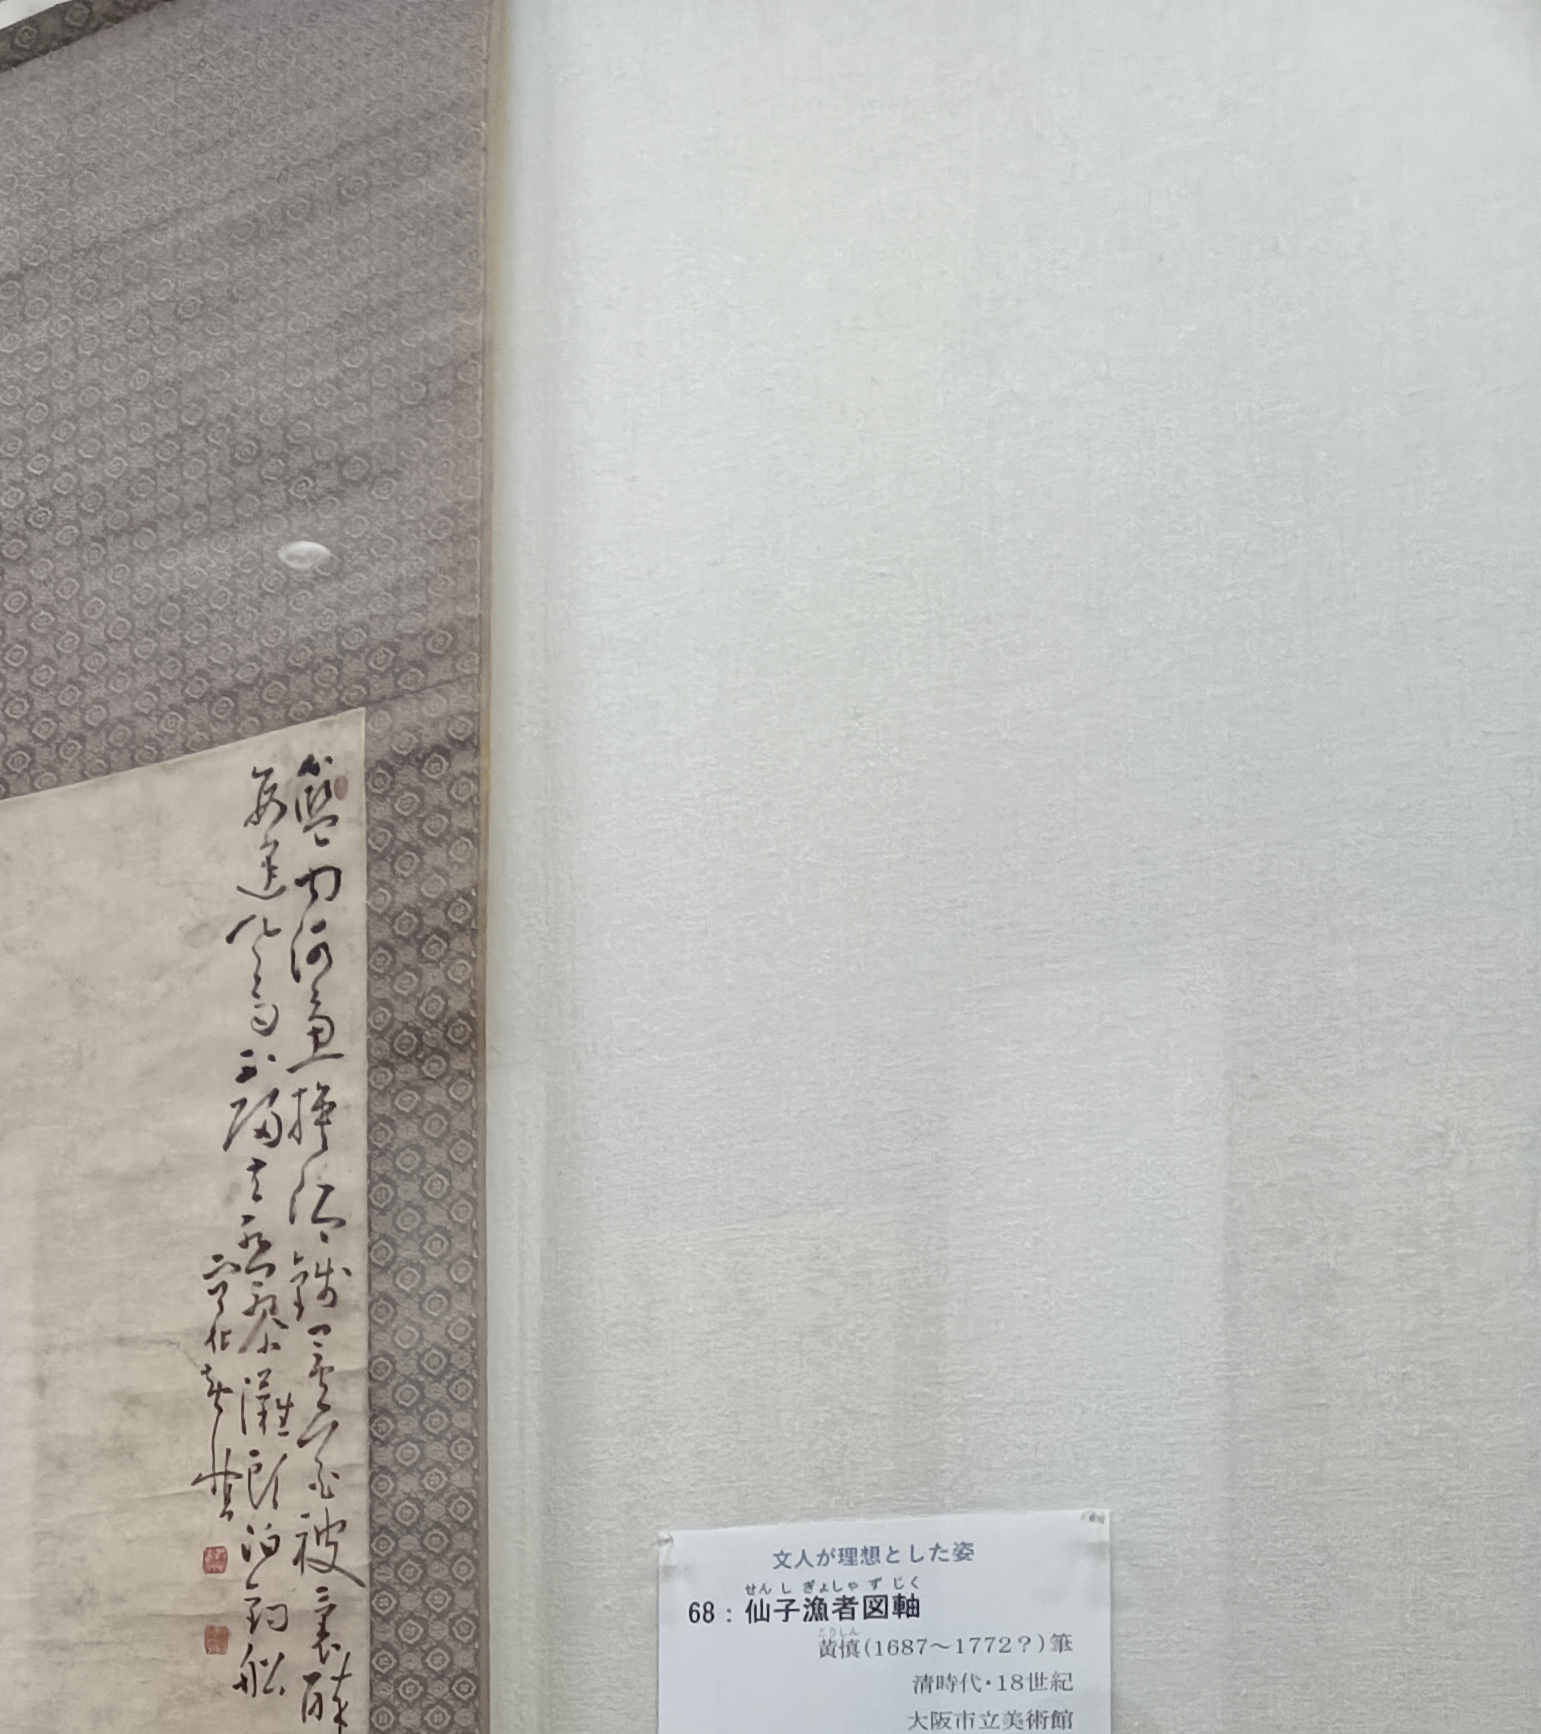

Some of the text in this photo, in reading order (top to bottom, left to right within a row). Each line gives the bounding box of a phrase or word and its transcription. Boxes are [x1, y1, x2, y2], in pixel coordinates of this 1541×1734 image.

[772, 1541, 975, 1570] 文人が理想とした姿
[912, 1672, 1074, 1695] 清時代・18世紀
[907, 1709, 1074, 1732] 大阪市立美術館
